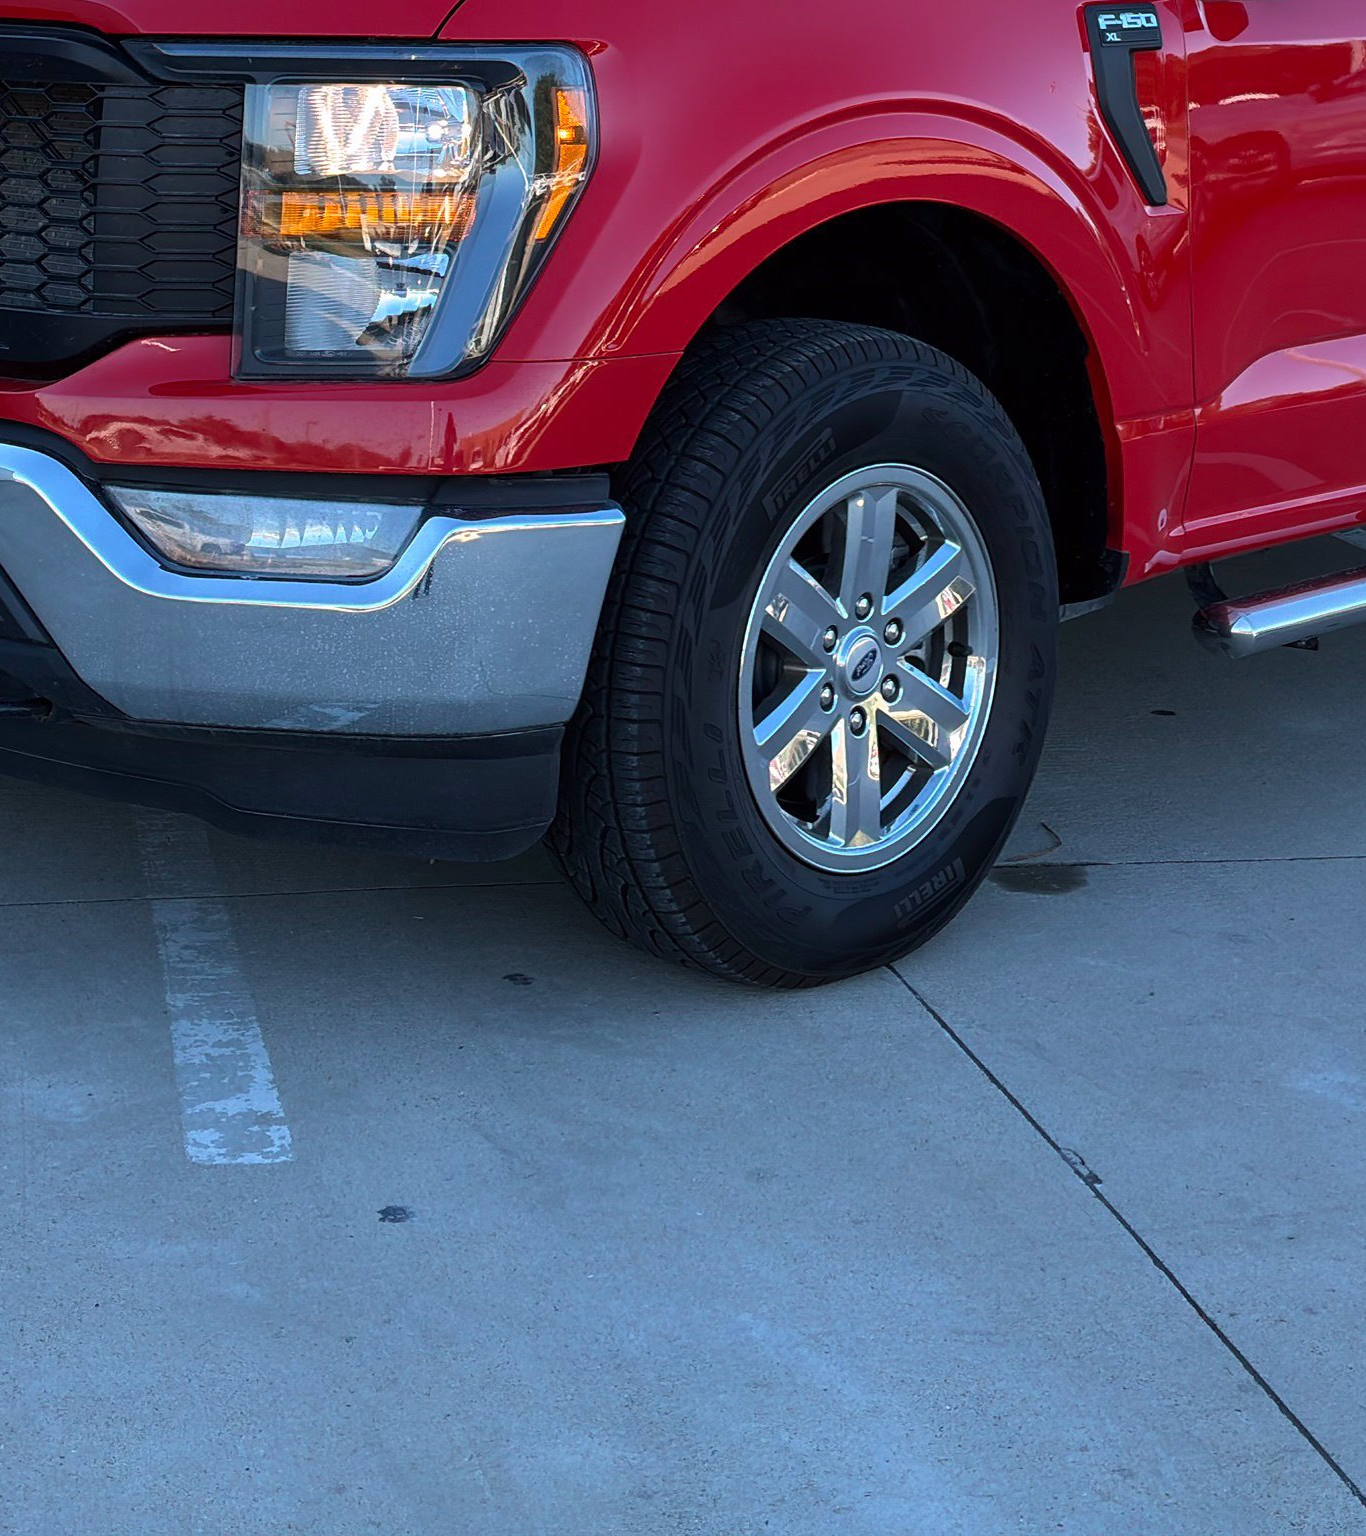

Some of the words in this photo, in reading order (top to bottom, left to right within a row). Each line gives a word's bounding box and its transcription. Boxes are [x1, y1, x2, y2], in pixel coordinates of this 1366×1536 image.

[1098, 12, 1158, 30] F-150
[1106, 32, 1121, 41] XL
[762, 427, 836, 521] PIRELLI
[703, 722, 813, 926] PIRELLI
[893, 856, 967, 928] PIRELLI
